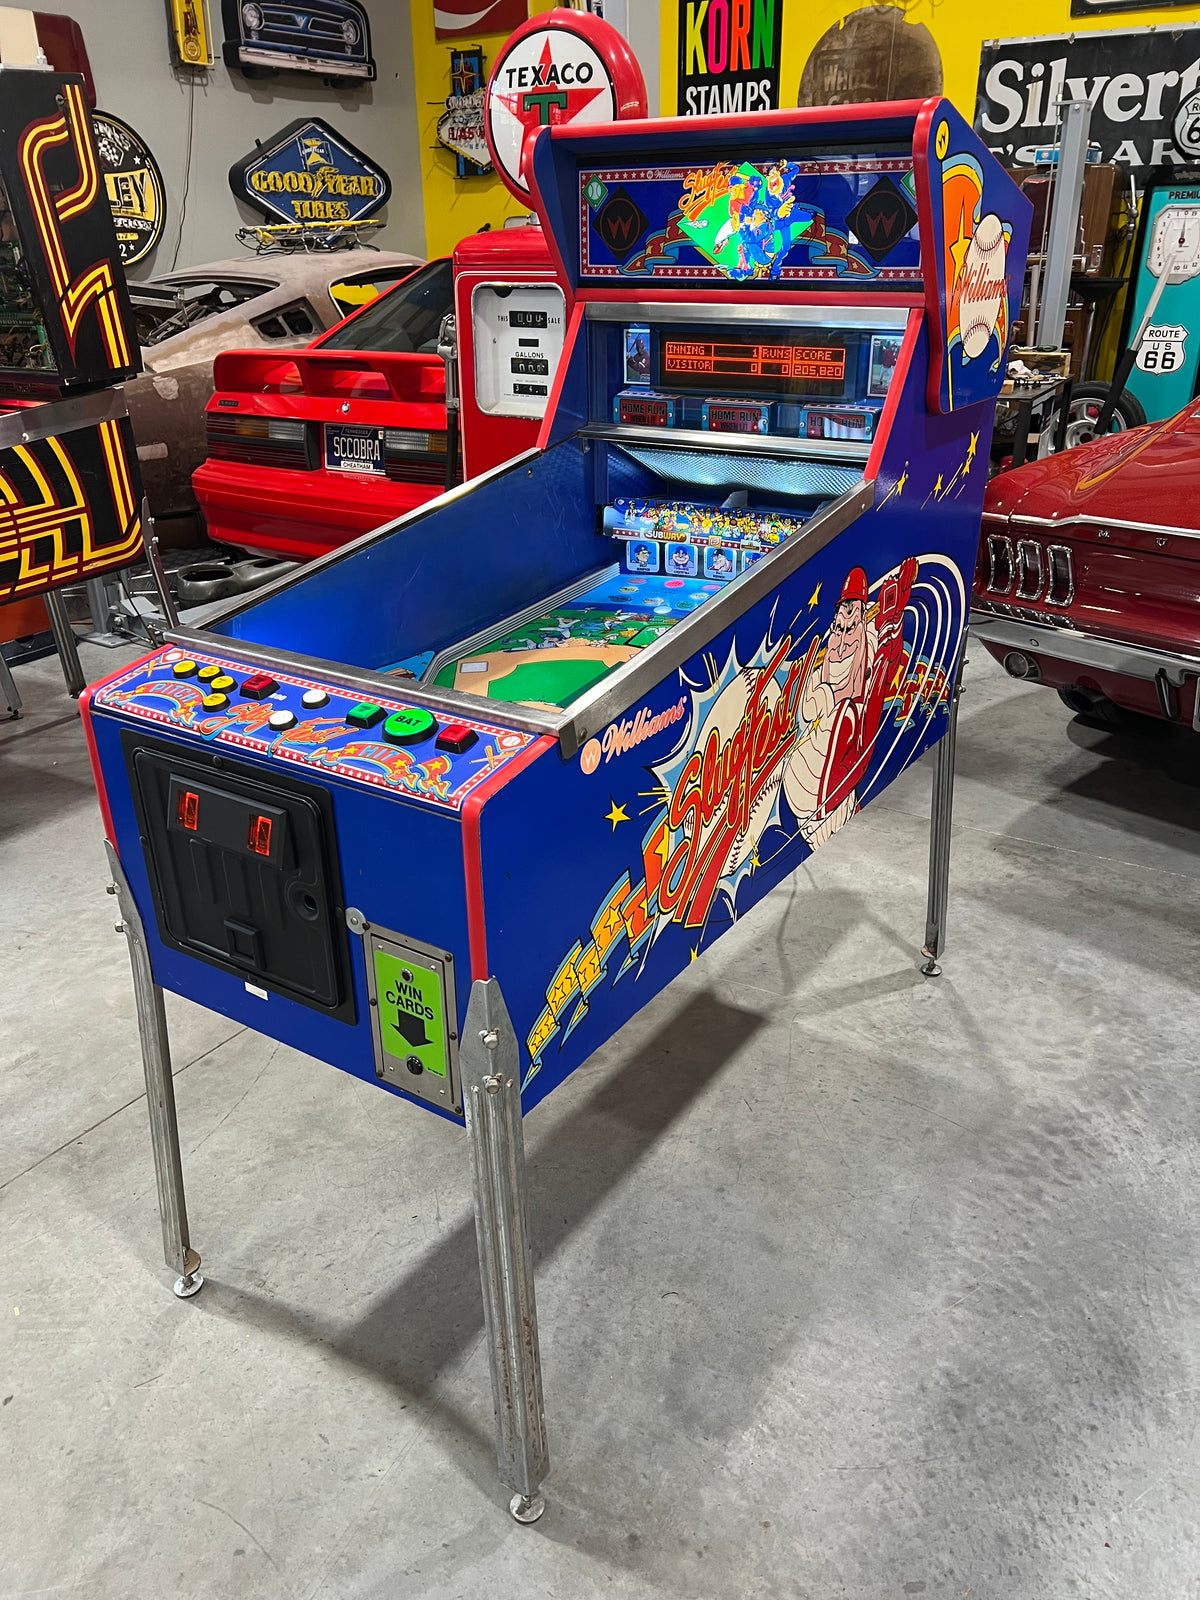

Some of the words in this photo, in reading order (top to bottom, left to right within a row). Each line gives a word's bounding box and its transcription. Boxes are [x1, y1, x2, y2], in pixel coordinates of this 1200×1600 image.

[685, 0, 775, 75] KORN
[505, 61, 594, 89] TEXACO
[685, 79, 772, 116] STAMPS
[251, 166, 379, 198] GOODYEAR
[291, 200, 351, 220] TIRES
[956, 262, 1008, 305] Williams
[547, 317, 561, 325] SALE
[1148, 329, 1181, 339] ROUTE
[514, 351, 545, 359] GALLONS
[667, 344, 705, 355] INNING
[752, 348, 758, 358] 1
[762, 348, 791, 360] RUNS
[795, 350, 832, 361] SCORE
[1143, 351, 1176, 370] 66
[667, 359, 712, 370] VISITOR
[750, 363, 758, 373] 0
[781, 364, 789, 374] 0
[794, 365, 842, 377] 205,820
[622, 402, 645, 414] HOME
[647, 404, 665, 415] RUN
[711, 410, 736, 421] HOME
[739, 411, 759, 422] RUN
[333, 436, 381, 461] SCCOBRA
[342, 461, 371, 470] CHEATHAM
[645, 529, 687, 542] SUBWAY
[148, 683, 200, 704] PITCH
[394, 715, 423, 727] BAT
[601, 696, 686, 764] Williams
[358, 744, 400, 761] HIT
[394, 979, 423, 1003] WIN
[385, 990, 434, 1021] CARDS
